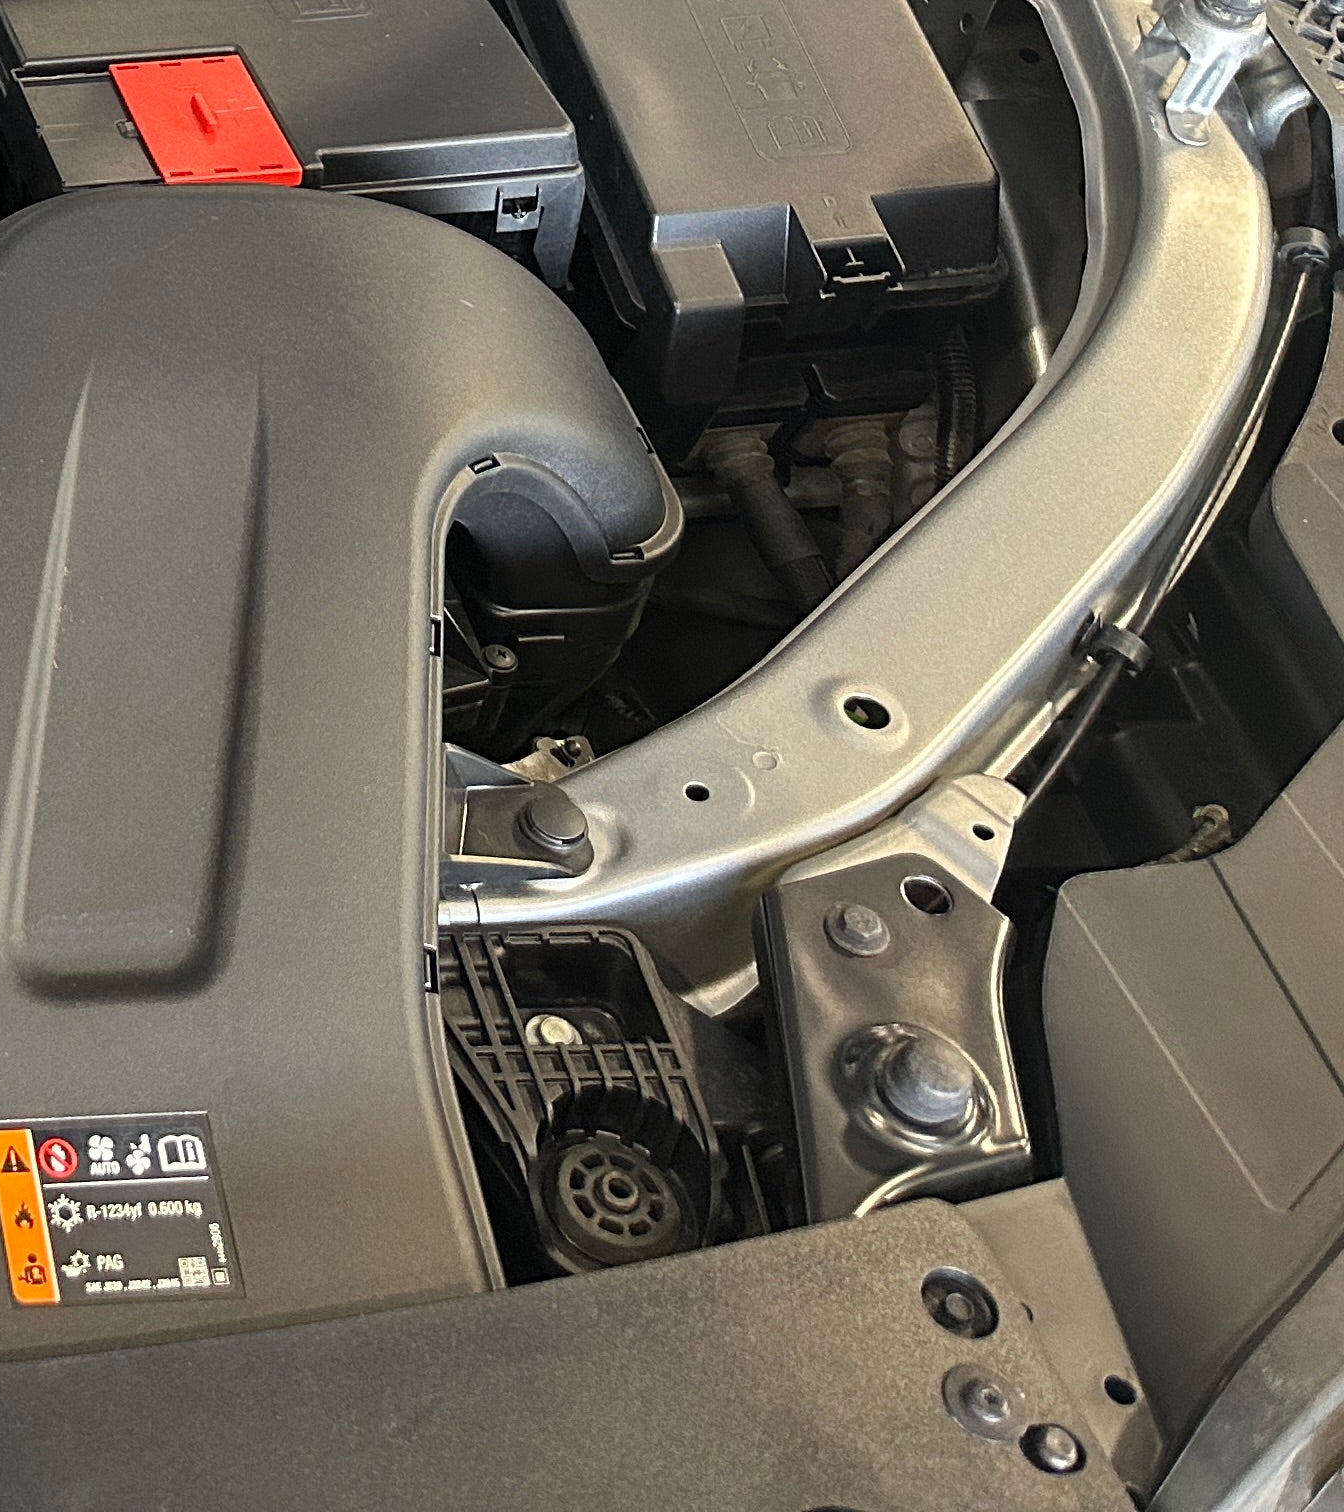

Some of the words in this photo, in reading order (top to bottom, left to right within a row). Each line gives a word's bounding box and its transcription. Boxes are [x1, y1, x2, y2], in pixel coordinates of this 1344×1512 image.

[90, 1161, 120, 1175] AUTO
[86, 1201, 143, 1222] R-1234yf
[184, 1199, 203, 1218] kg
[96, 1254, 125, 1271] PAG
